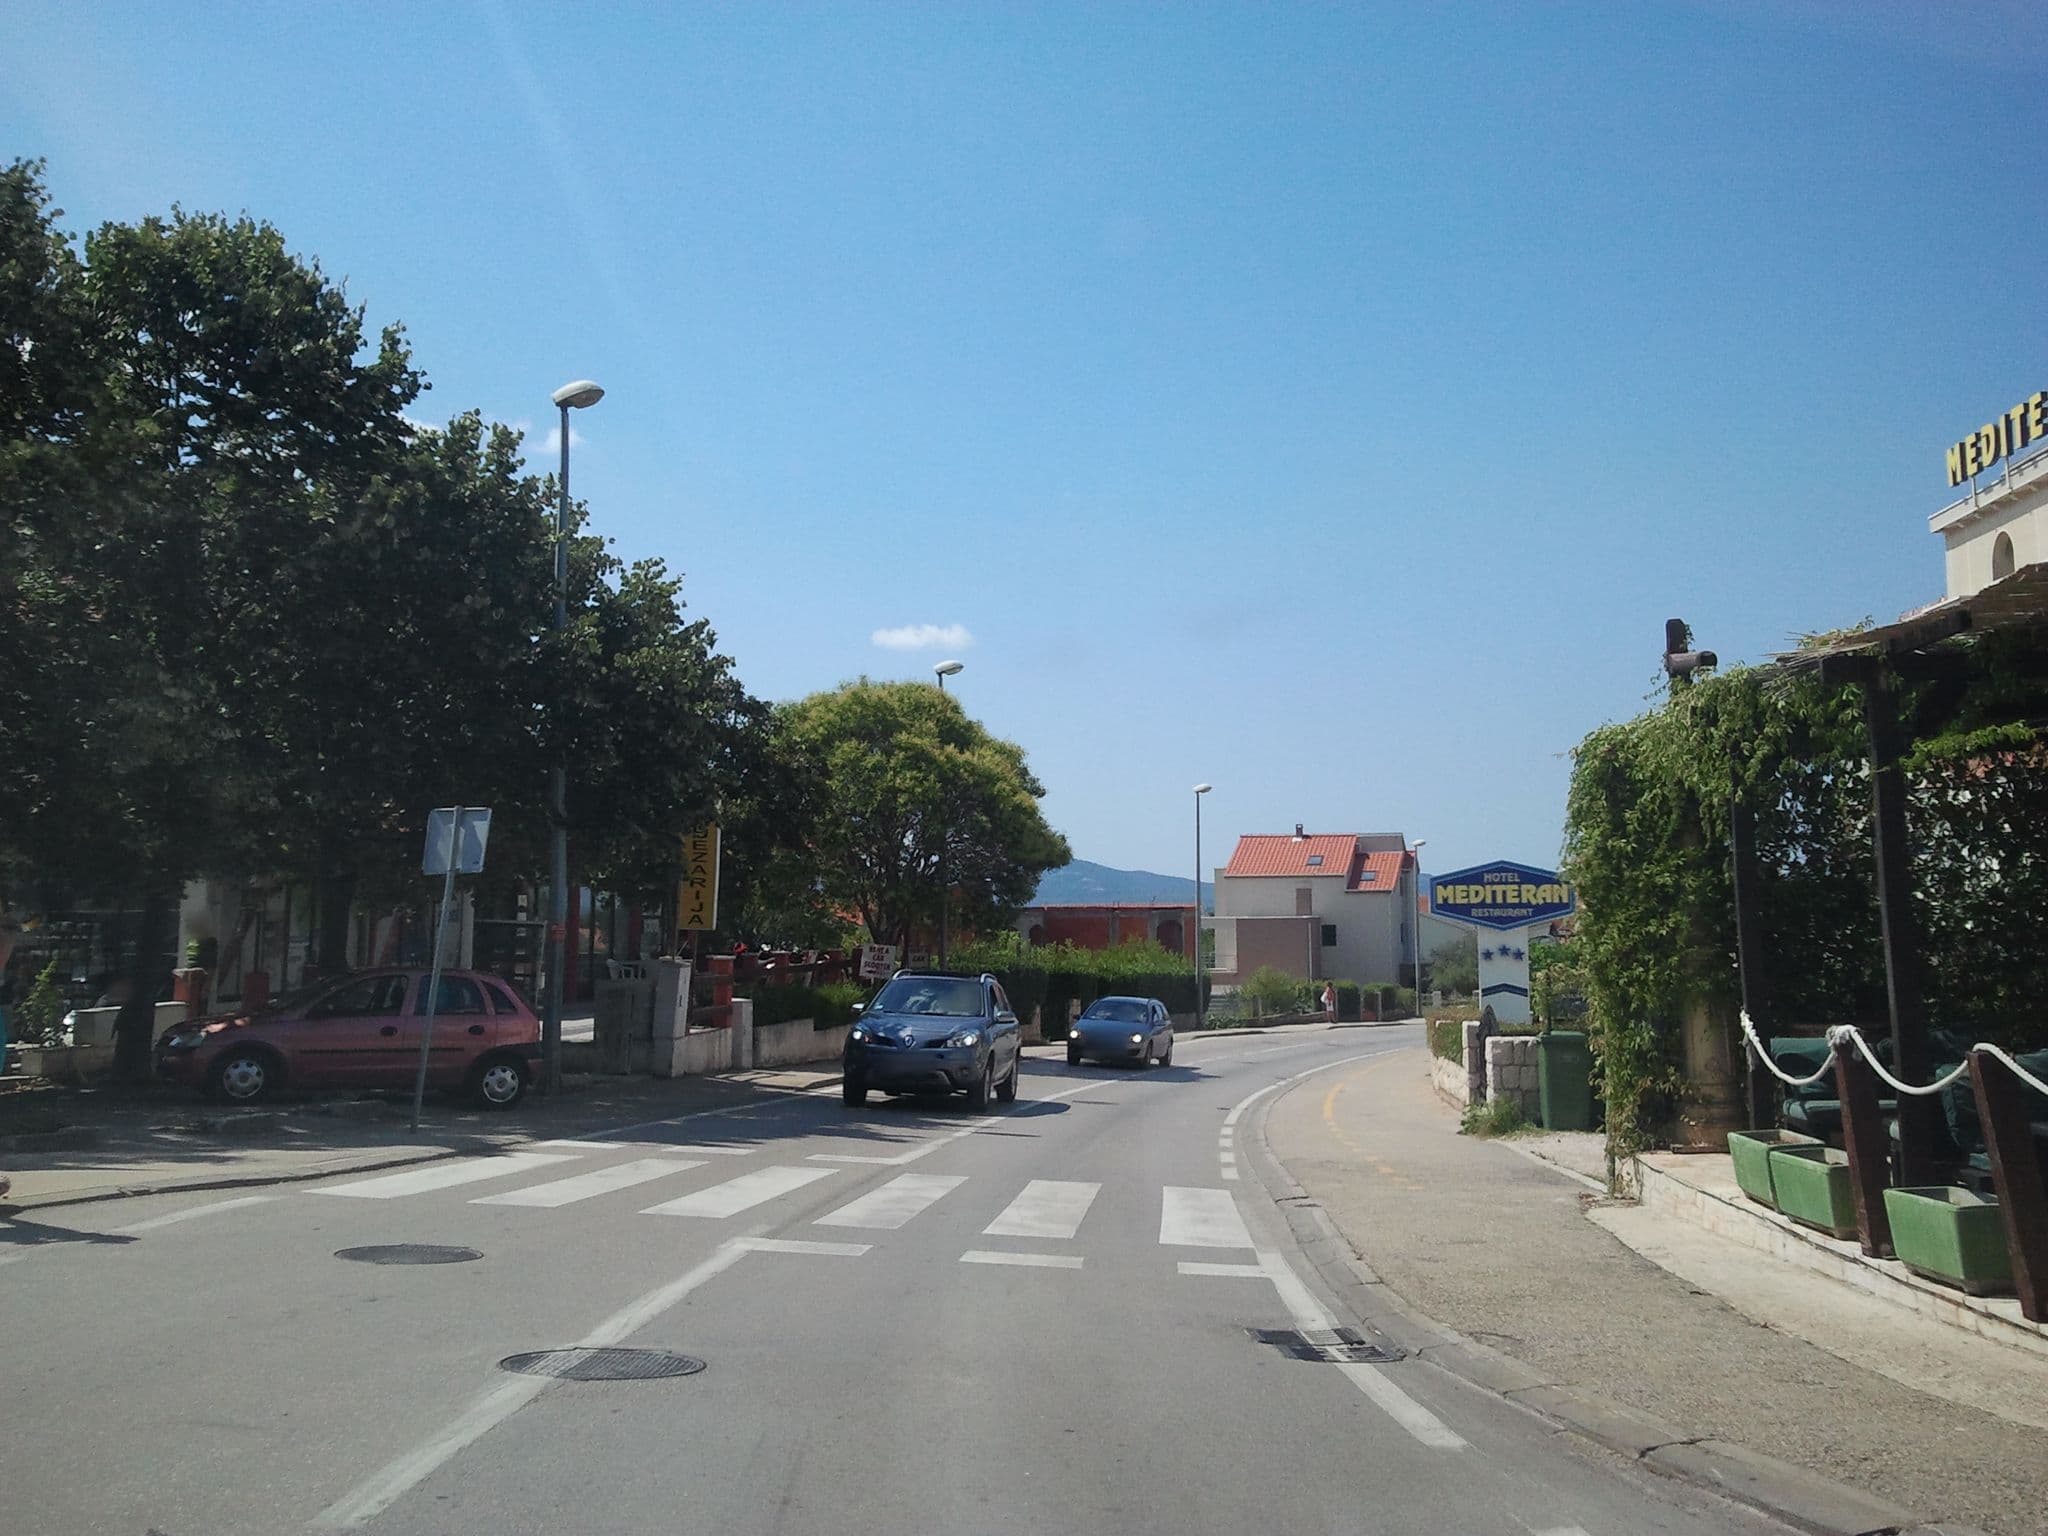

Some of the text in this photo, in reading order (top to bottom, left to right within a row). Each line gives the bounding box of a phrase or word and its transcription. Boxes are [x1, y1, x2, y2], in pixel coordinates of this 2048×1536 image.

[1945, 391, 2047, 487] MEDITE
[1483, 872, 1520, 882] HOTEL
[1436, 884, 1569, 905] MEDITERAN
[1471, 908, 1534, 917] RESTAURANT
